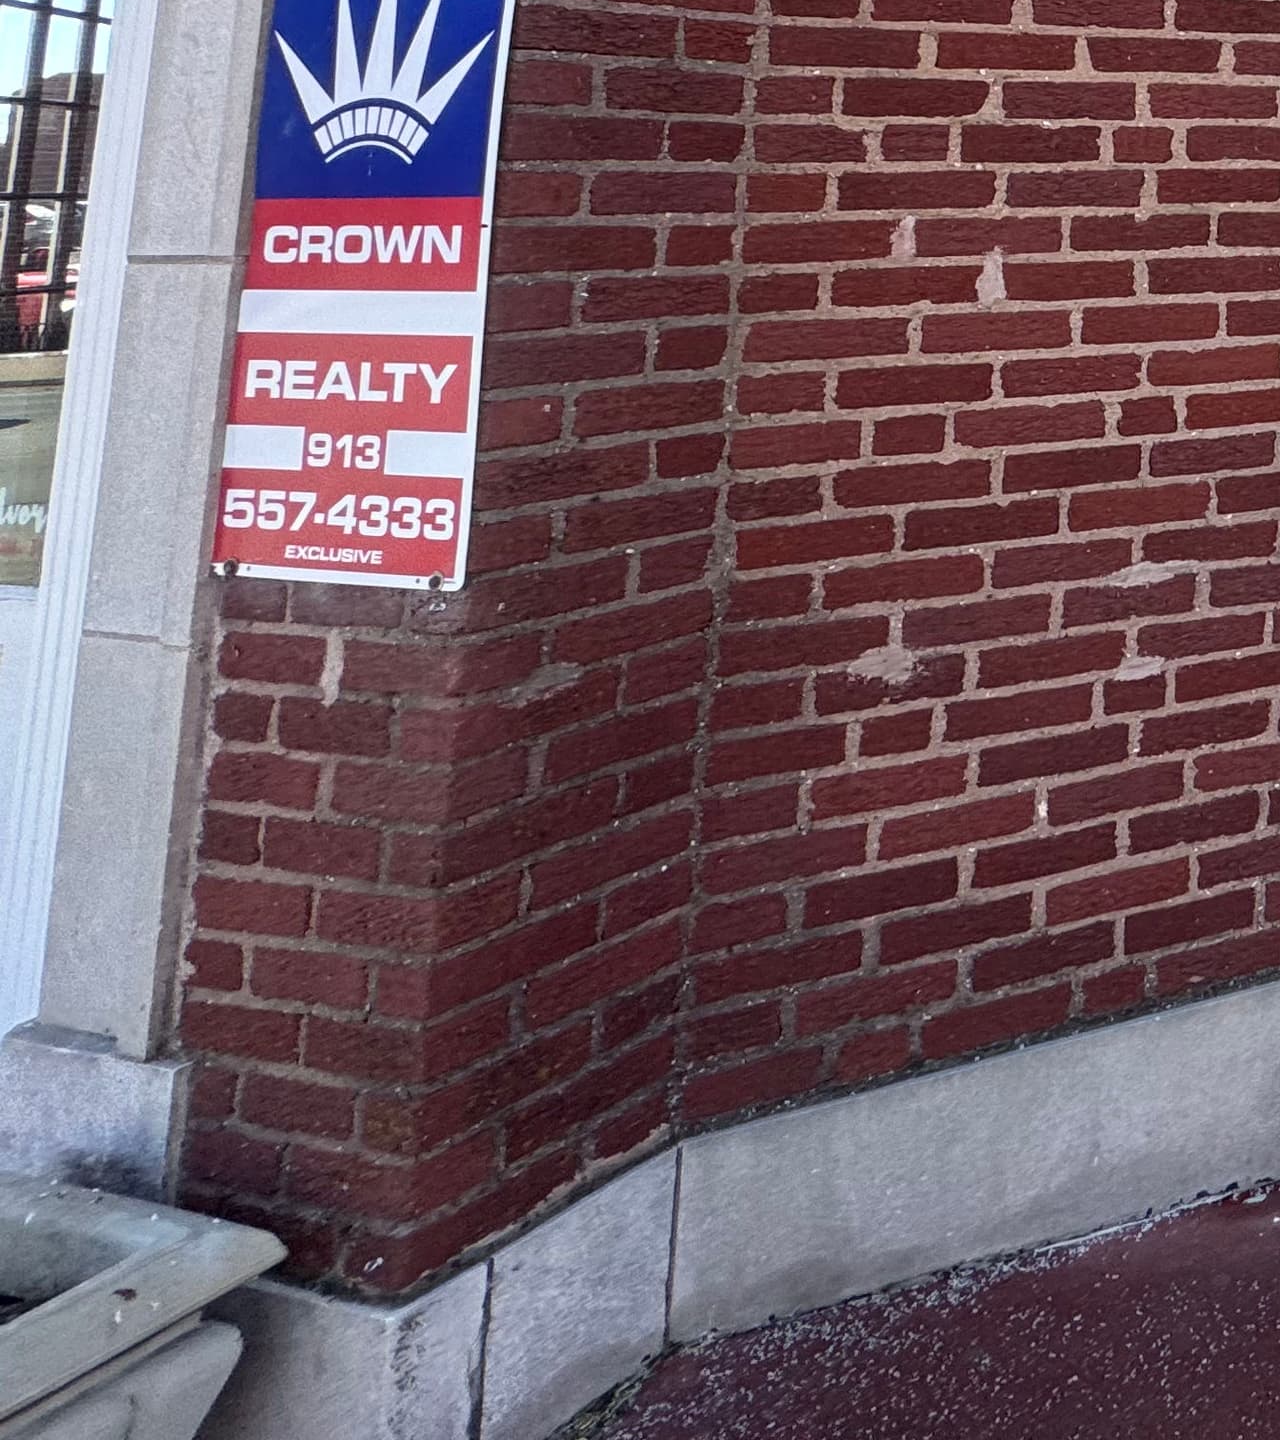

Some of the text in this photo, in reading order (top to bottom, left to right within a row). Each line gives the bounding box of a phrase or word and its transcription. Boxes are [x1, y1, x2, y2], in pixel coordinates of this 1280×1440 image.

[263, 225, 463, 264] CROWN
[244, 359, 458, 404] REALTY
[306, 432, 381, 469] 913
[284, 544, 383, 565] EXCLUSIVE
